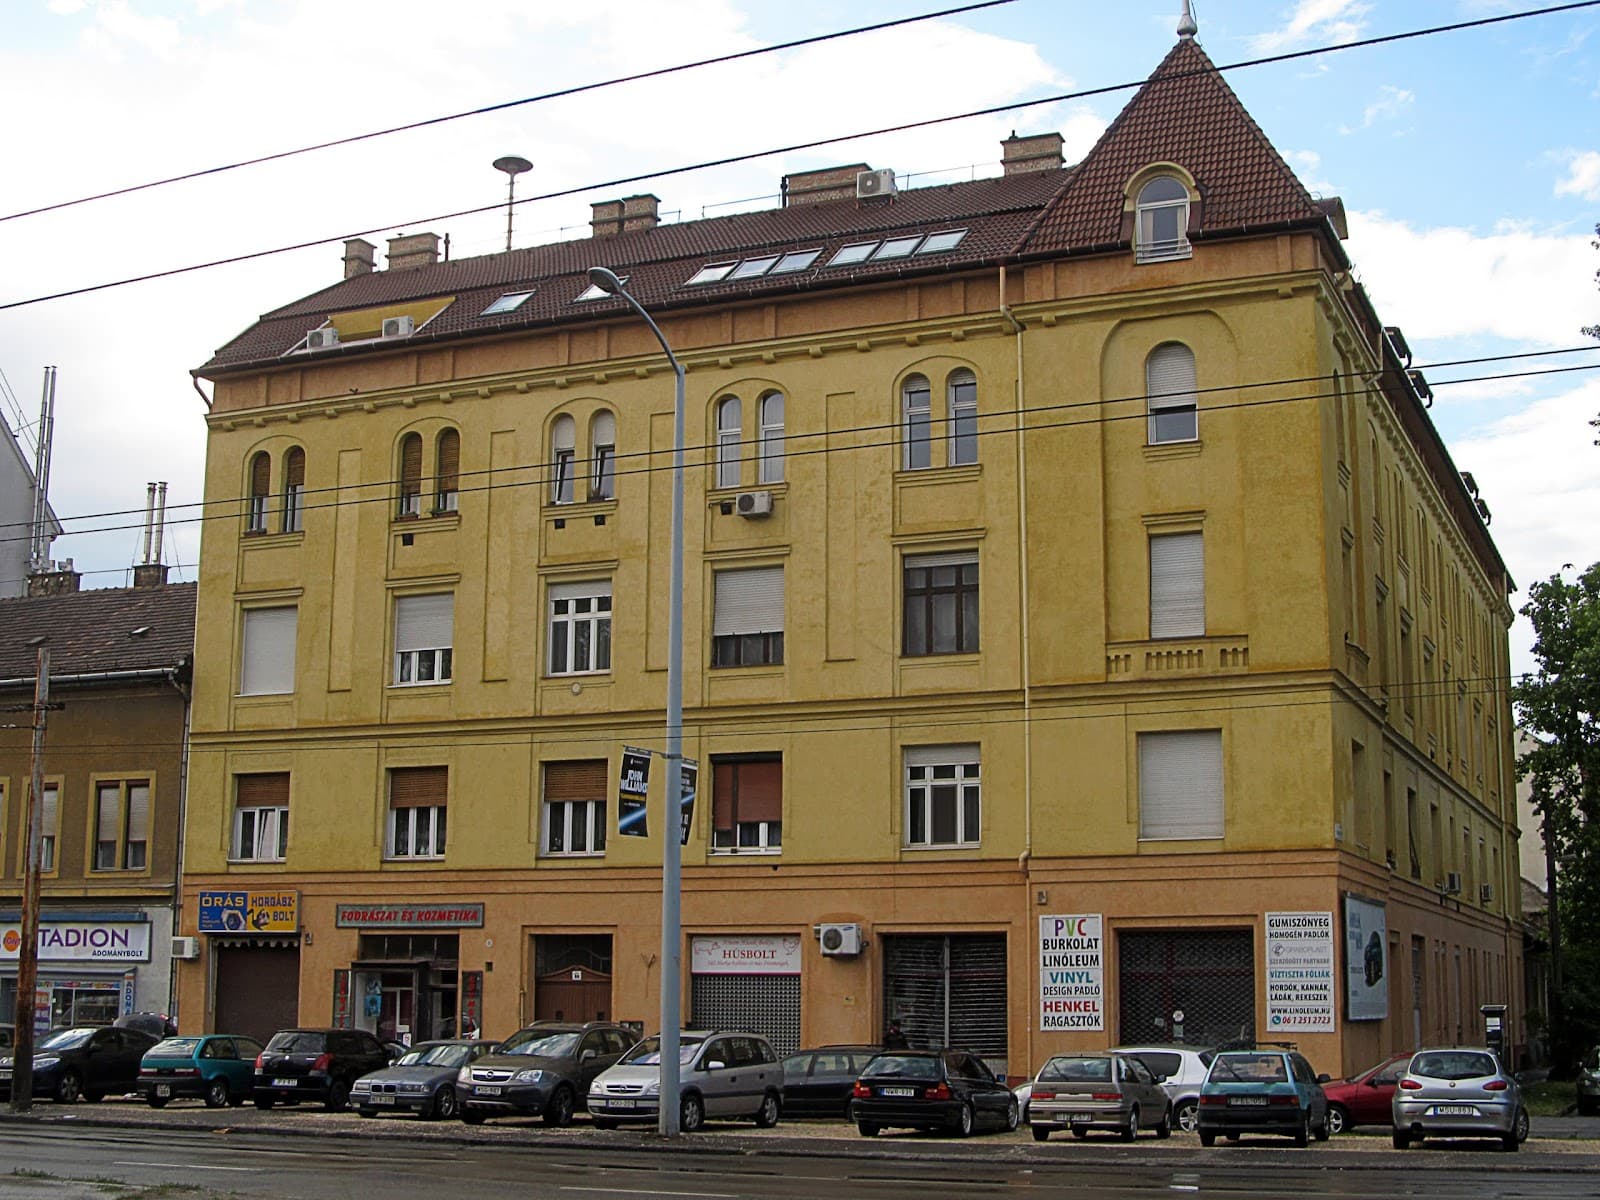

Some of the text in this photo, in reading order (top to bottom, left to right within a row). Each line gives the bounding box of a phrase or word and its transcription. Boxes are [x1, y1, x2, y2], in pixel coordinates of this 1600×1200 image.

[202, 893, 244, 907] ÓRÁS
[273, 911, 295, 921] BOLT
[341, 908, 479, 922] FODRÁSZAT ÉS KOZMETIKA
[1054, 919, 1087, 937] PVC
[1269, 930, 1330, 939] HOMOGÉN PADLÓK
[1043, 938, 1100, 950] BURKOLAT
[723, 947, 777, 959] HÚSBOLT
[1043, 952, 1100, 967] LINÓLEUM
[1050, 971, 1093, 984] VINYL
[1270, 970, 1303, 979] VÍZTISZTA
[1043, 984, 1100, 996] DESIGN PADLÓ
[1295, 993, 1328, 1002] REKESZEK
[1043, 1001, 1100, 1013] HENKEL
[1043, 1013, 1101, 1027] RAGASZTÓK
[1282, 1016, 1291, 1024] 06
